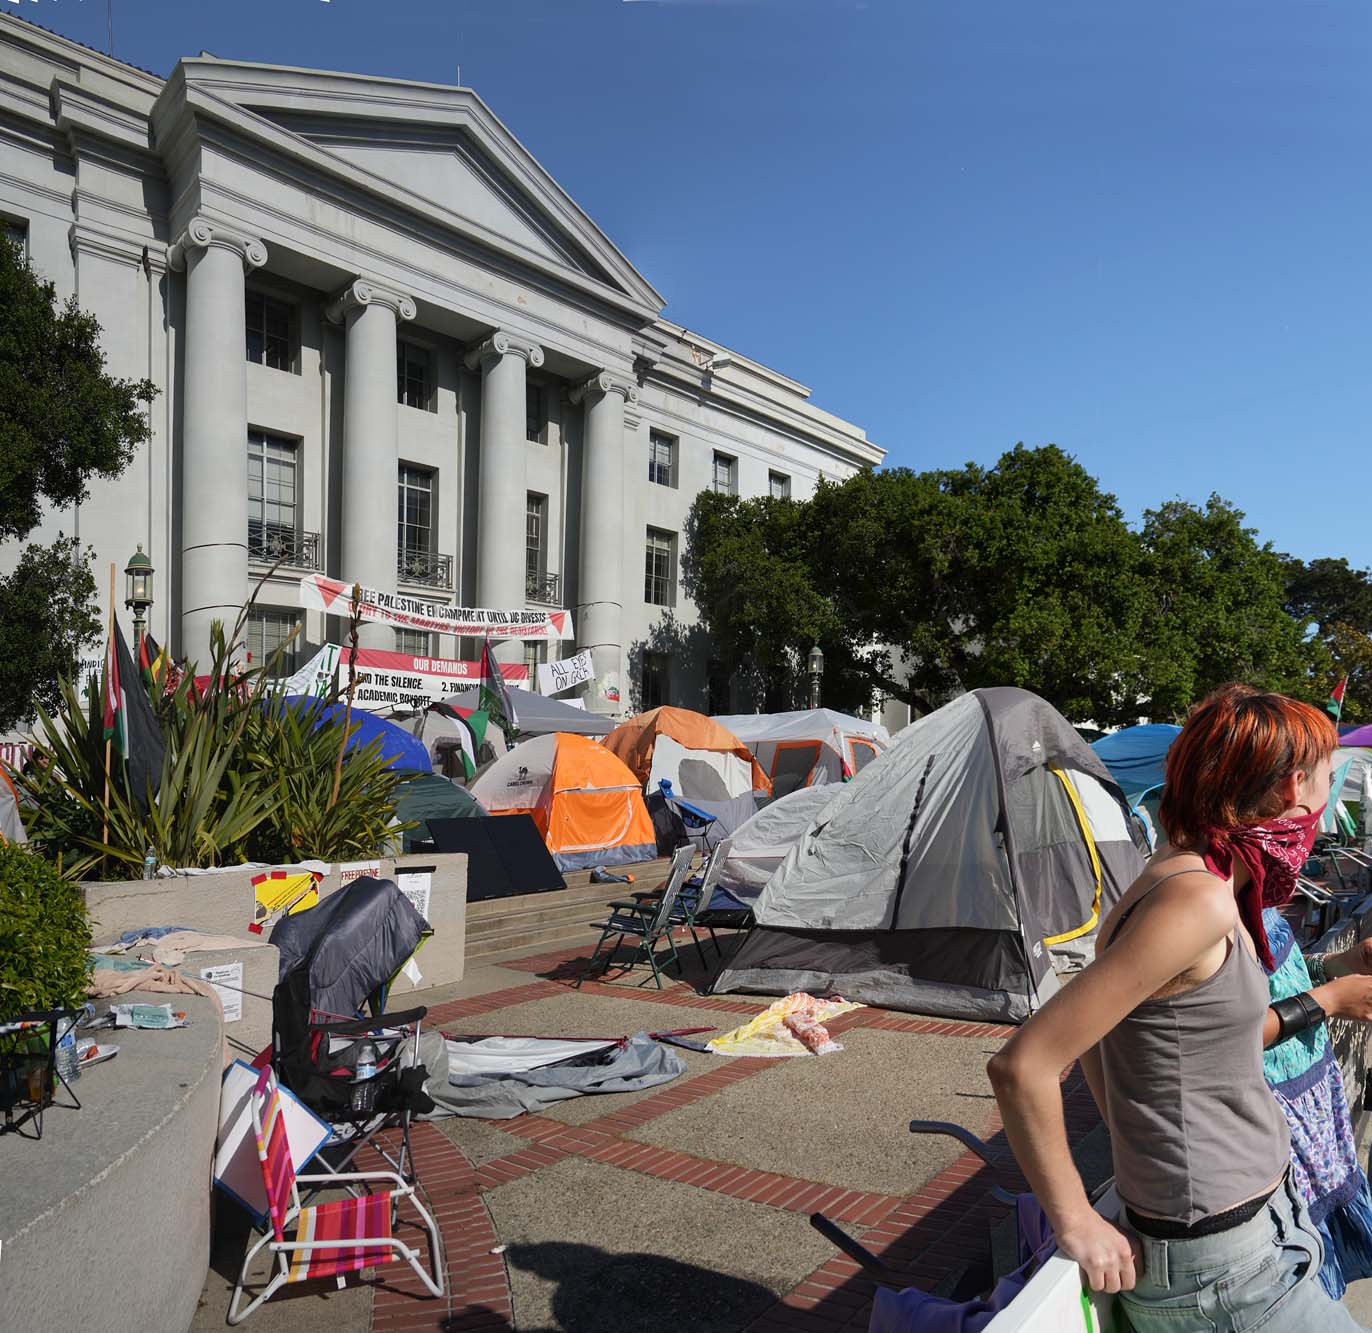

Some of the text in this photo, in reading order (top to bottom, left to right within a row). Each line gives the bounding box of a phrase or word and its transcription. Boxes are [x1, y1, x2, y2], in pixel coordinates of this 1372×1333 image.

[378, 593, 424, 616] PALESTINE
[487, 611, 509, 624] UNTIL
[510, 612, 519, 624] UC
[521, 612, 546, 624] DIVESTS
[393, 613, 409, 624] THE
[413, 657, 468, 675] OUR DEMANDS
[550, 653, 587, 677] ALL EYES
[374, 674, 390, 687] THE
[391, 675, 424, 690] SILENCE.
[442, 681, 449, 692] 2.
[555, 675, 568, 690] ON
[357, 689, 398, 703] ACADEMIC
